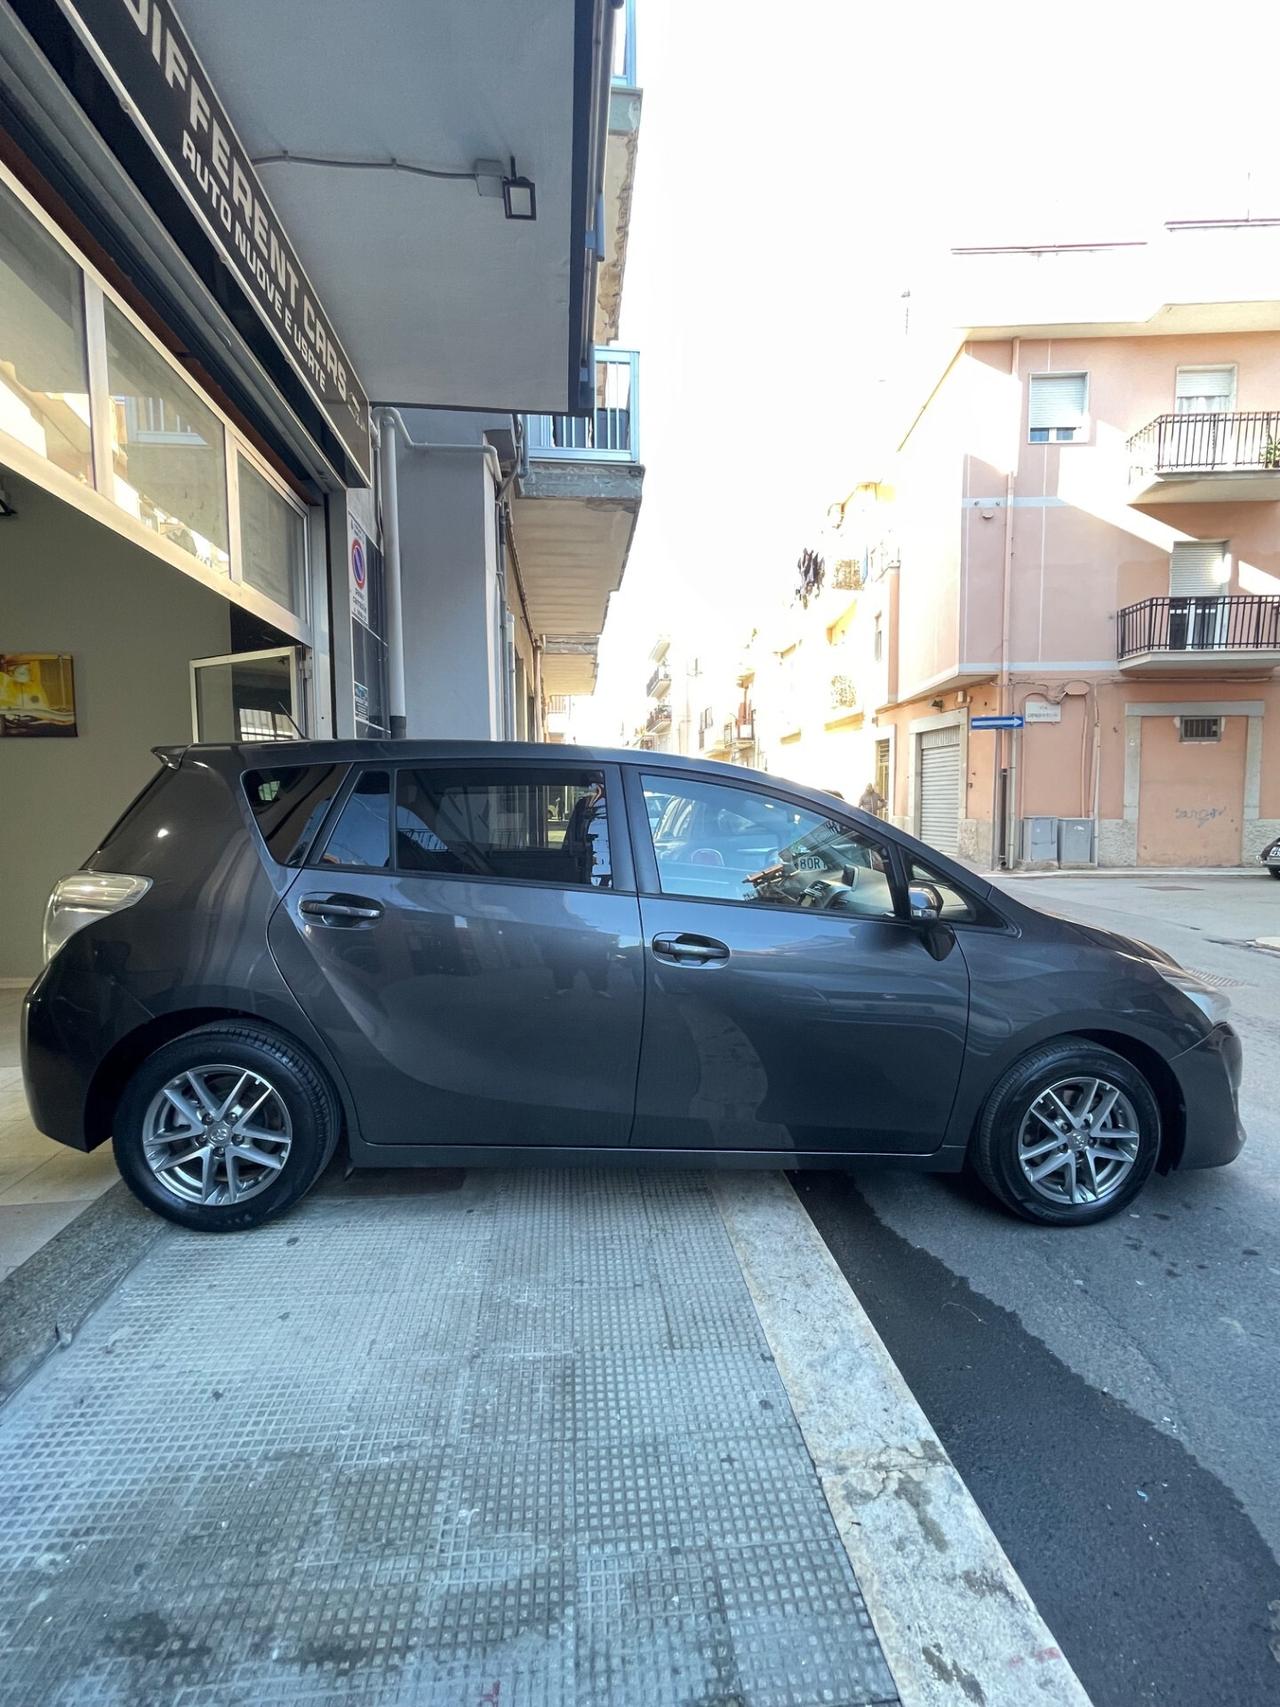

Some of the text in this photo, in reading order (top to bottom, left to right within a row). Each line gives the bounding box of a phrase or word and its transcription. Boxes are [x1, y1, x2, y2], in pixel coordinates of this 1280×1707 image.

[182, 130, 327, 393] AUTO NUOVE E USATE
[303, 294, 347, 402] CARS
